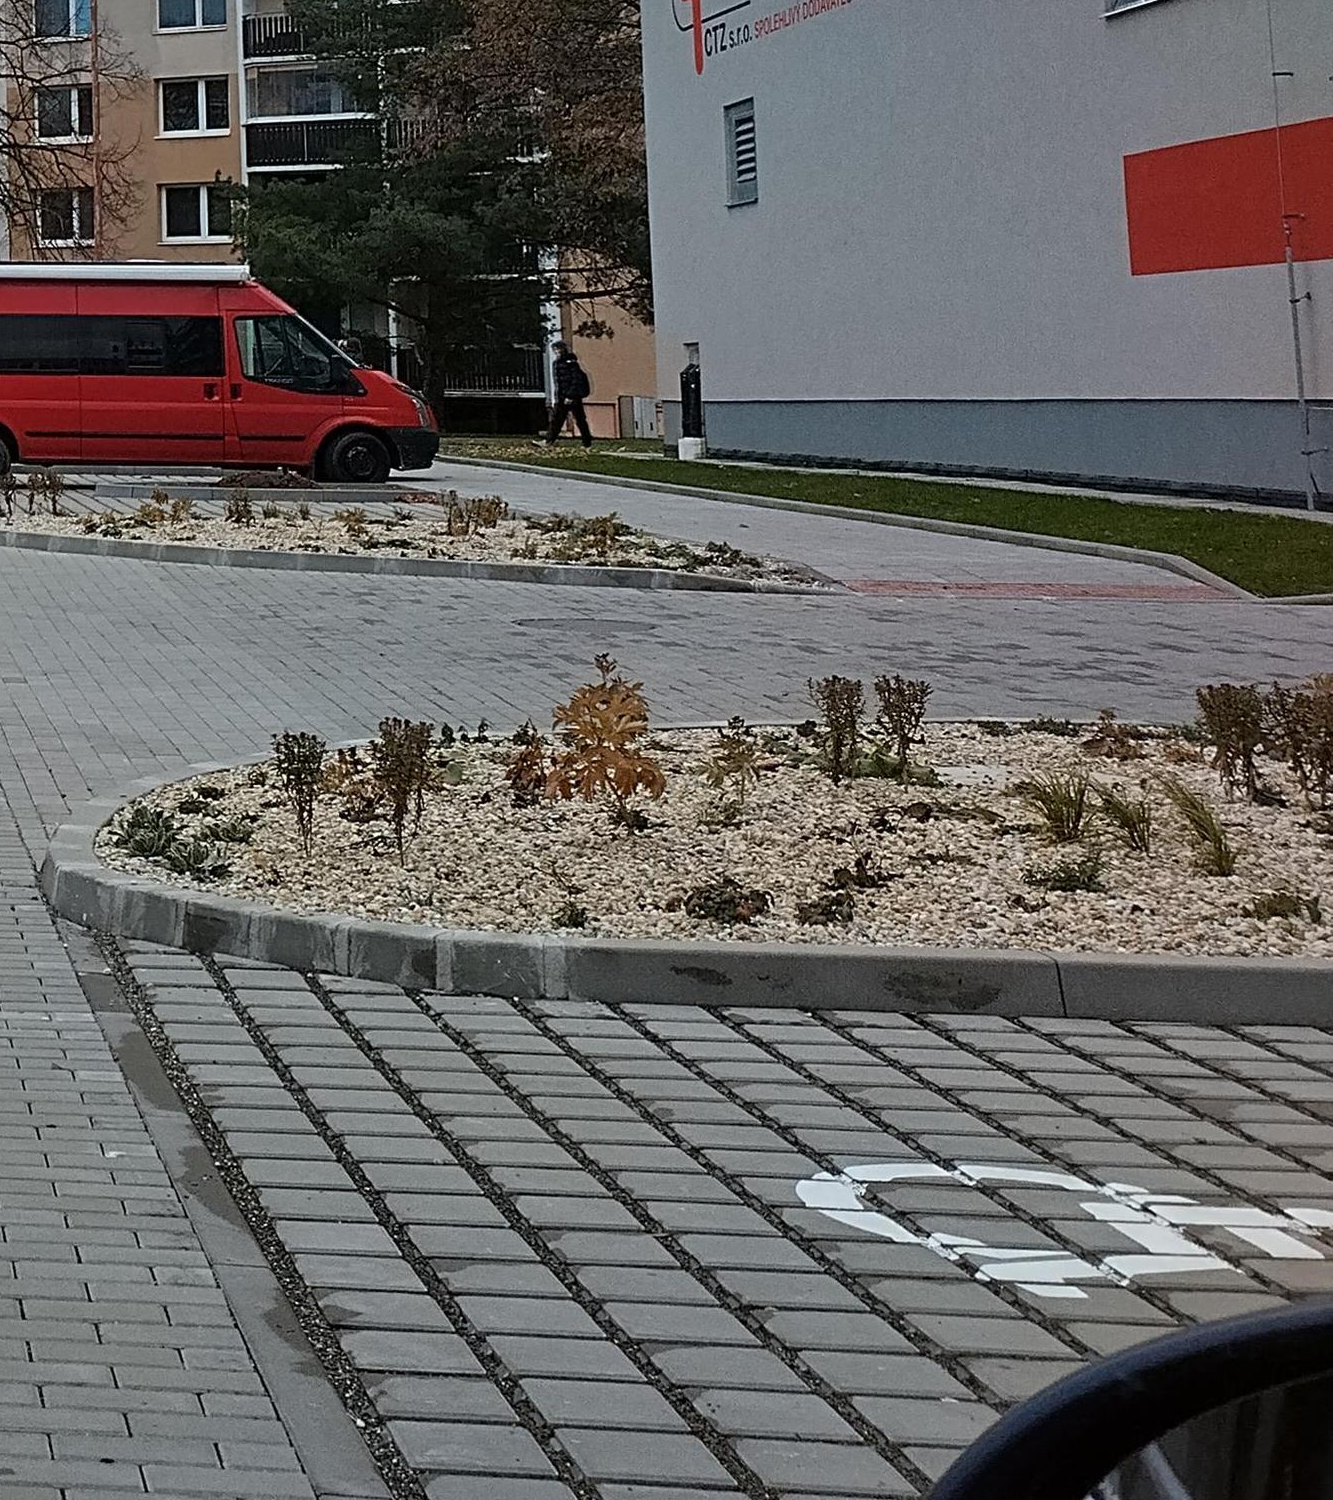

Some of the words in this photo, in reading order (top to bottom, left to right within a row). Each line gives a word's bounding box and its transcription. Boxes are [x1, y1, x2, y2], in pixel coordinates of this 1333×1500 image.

[704, 22, 728, 57] CTZ
[728, 24, 753, 49] s.r.o.
[754, 4, 802, 39] SPOLEHLIVÝ
